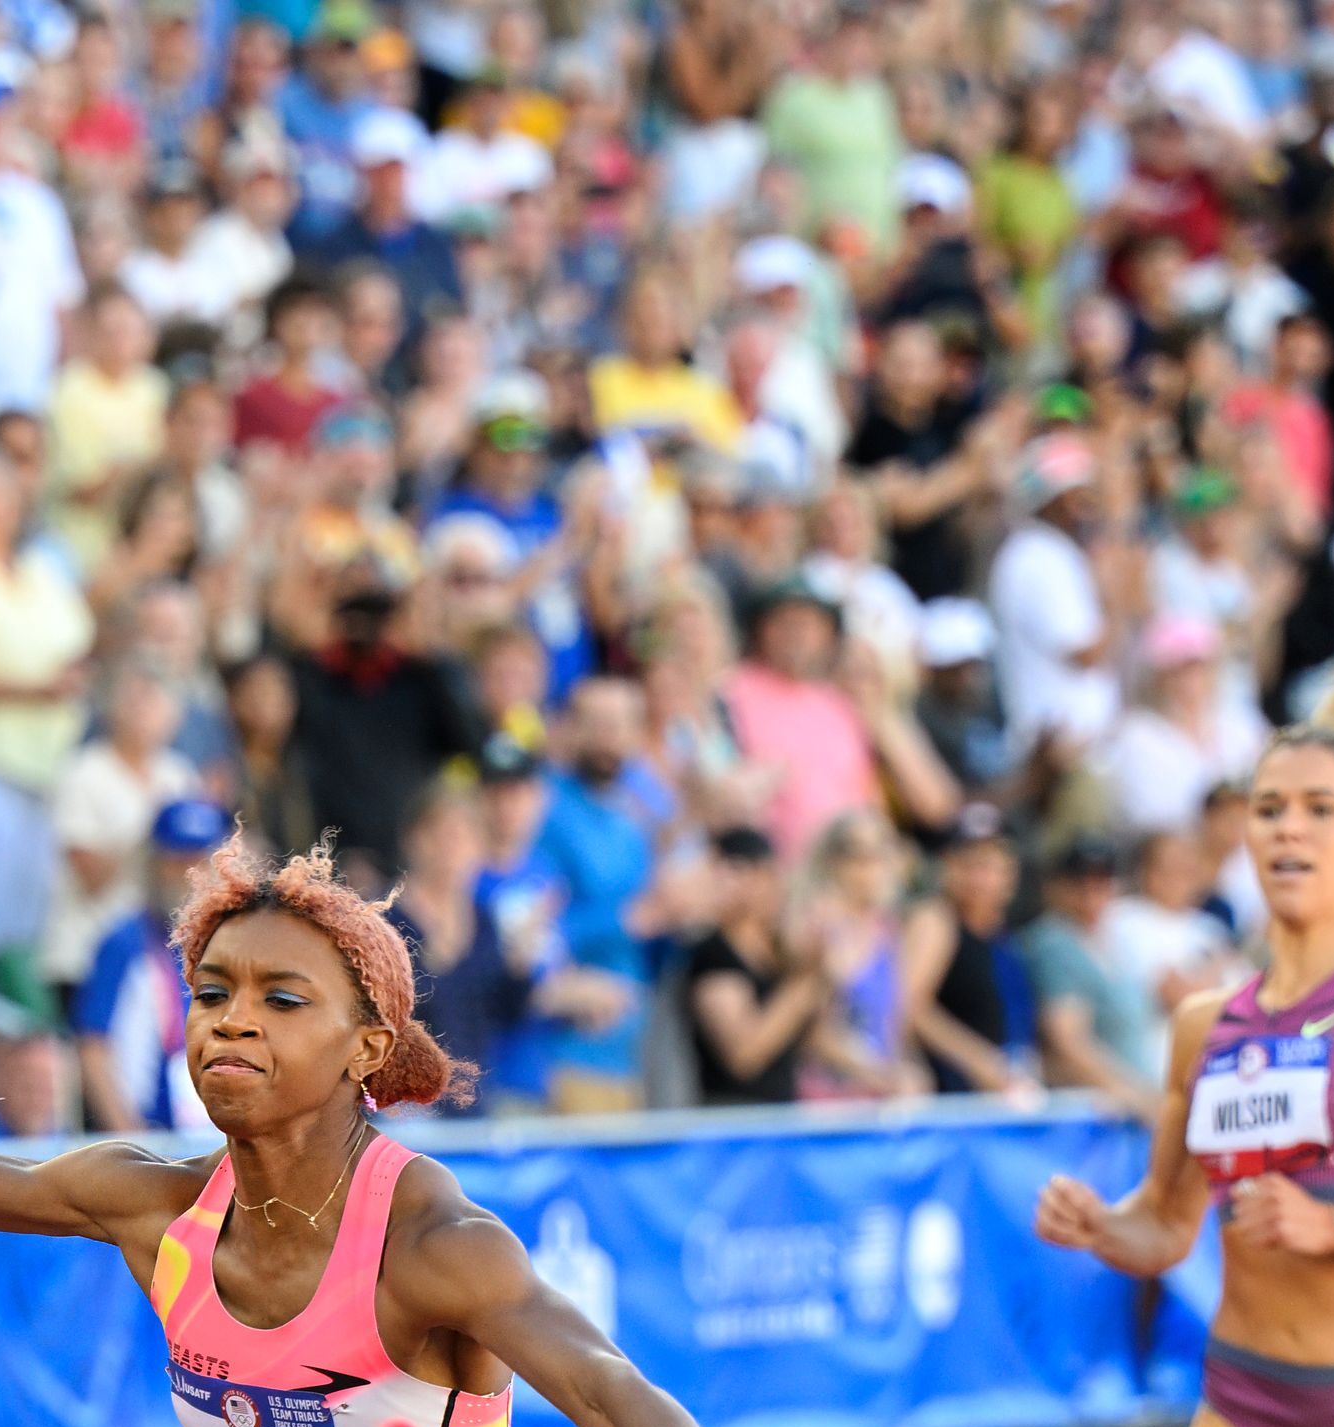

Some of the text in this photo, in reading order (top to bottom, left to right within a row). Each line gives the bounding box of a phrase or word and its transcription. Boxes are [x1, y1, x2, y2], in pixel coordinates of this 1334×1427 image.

[1213, 1093, 1290, 1133] WILSON
[184, 1384, 211, 1401] USATF
[268, 1396, 321, 1411] U.S. OLYMPIC
[270, 1408, 324, 1422] TEAM TRIALS
